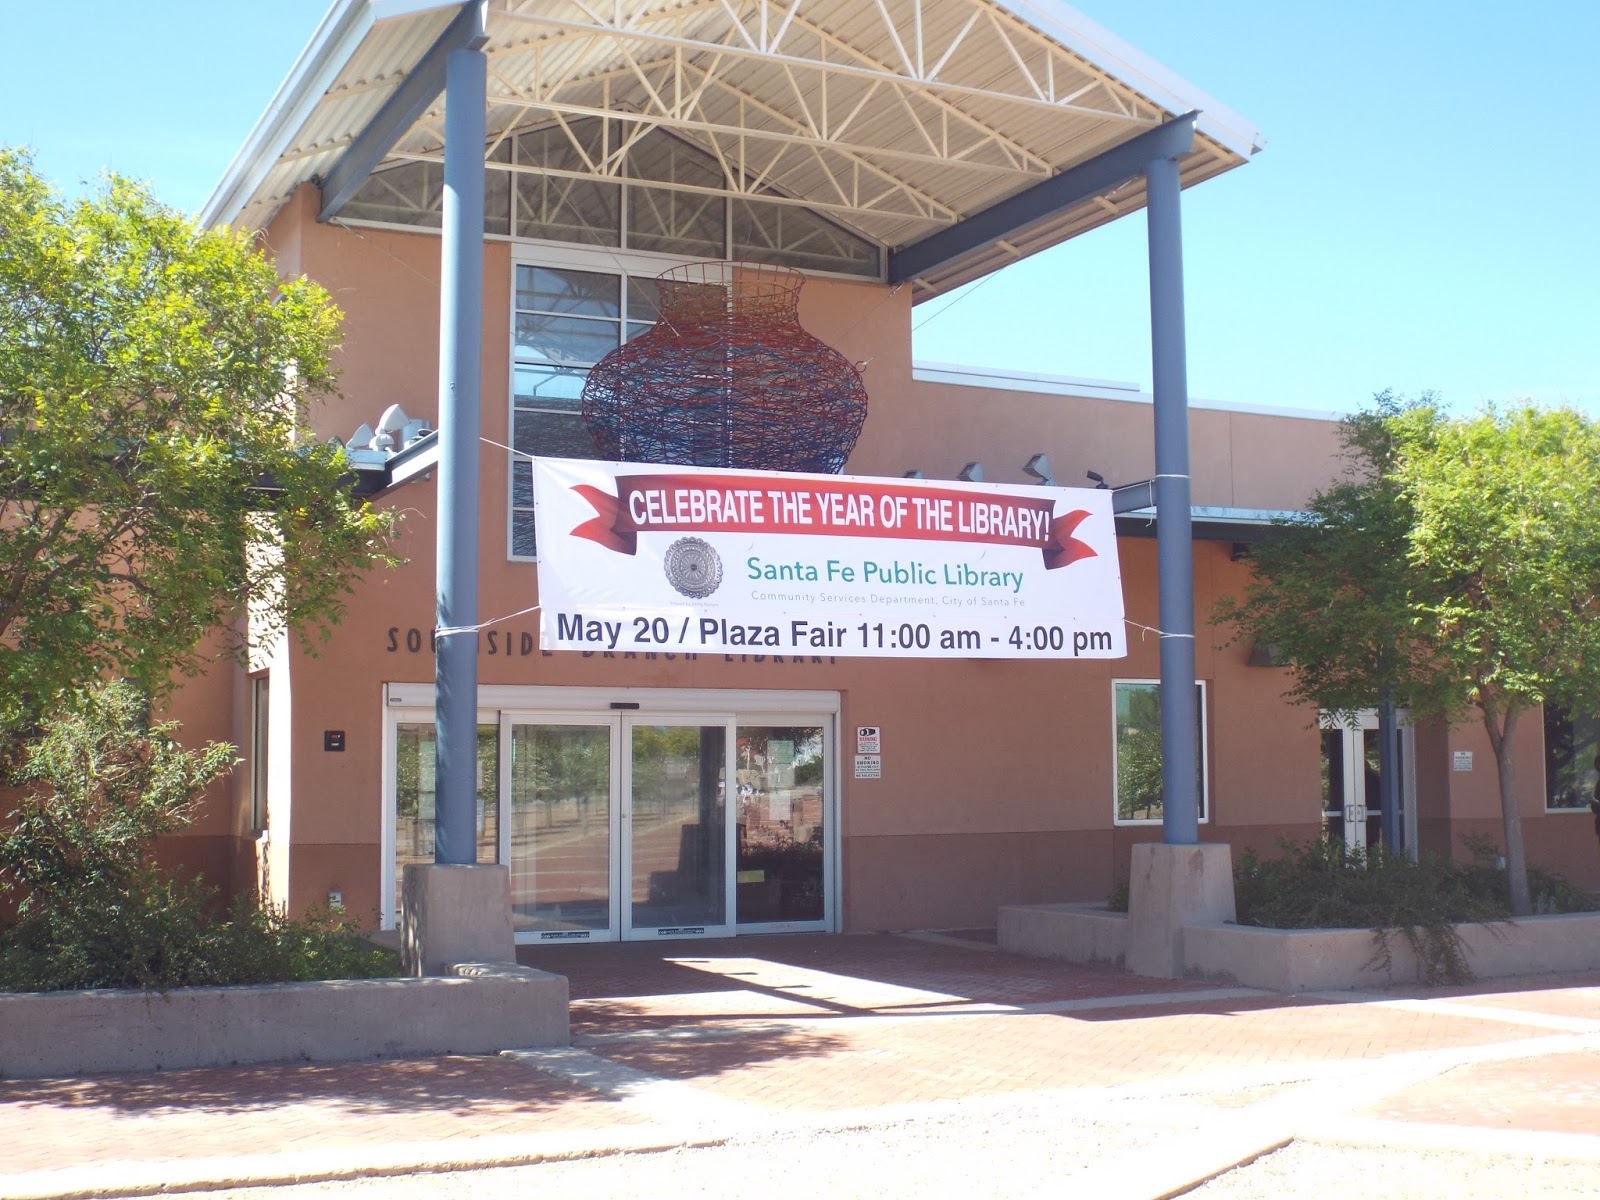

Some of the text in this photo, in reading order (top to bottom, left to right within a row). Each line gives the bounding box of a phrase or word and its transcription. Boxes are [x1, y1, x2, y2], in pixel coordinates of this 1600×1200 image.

[629, 489, 1050, 542] CELEBRATE THE YEAR OF THE LIBRARY!
[747, 556, 1024, 594] Santa Fe Public Library
[751, 590, 1026, 608] Community Services Department, City of Santa Fe
[557, 612, 622, 650] May
[633, 616, 670, 645] 20
[678, 617, 690, 643] /
[700, 618, 780, 647] Plaza
[791, 620, 847, 648] Fair
[857, 622, 931, 649] 11:00
[939, 628, 981, 650] am
[1008, 625, 1064, 651] 4:00
[1073, 630, 1113, 657] pm
